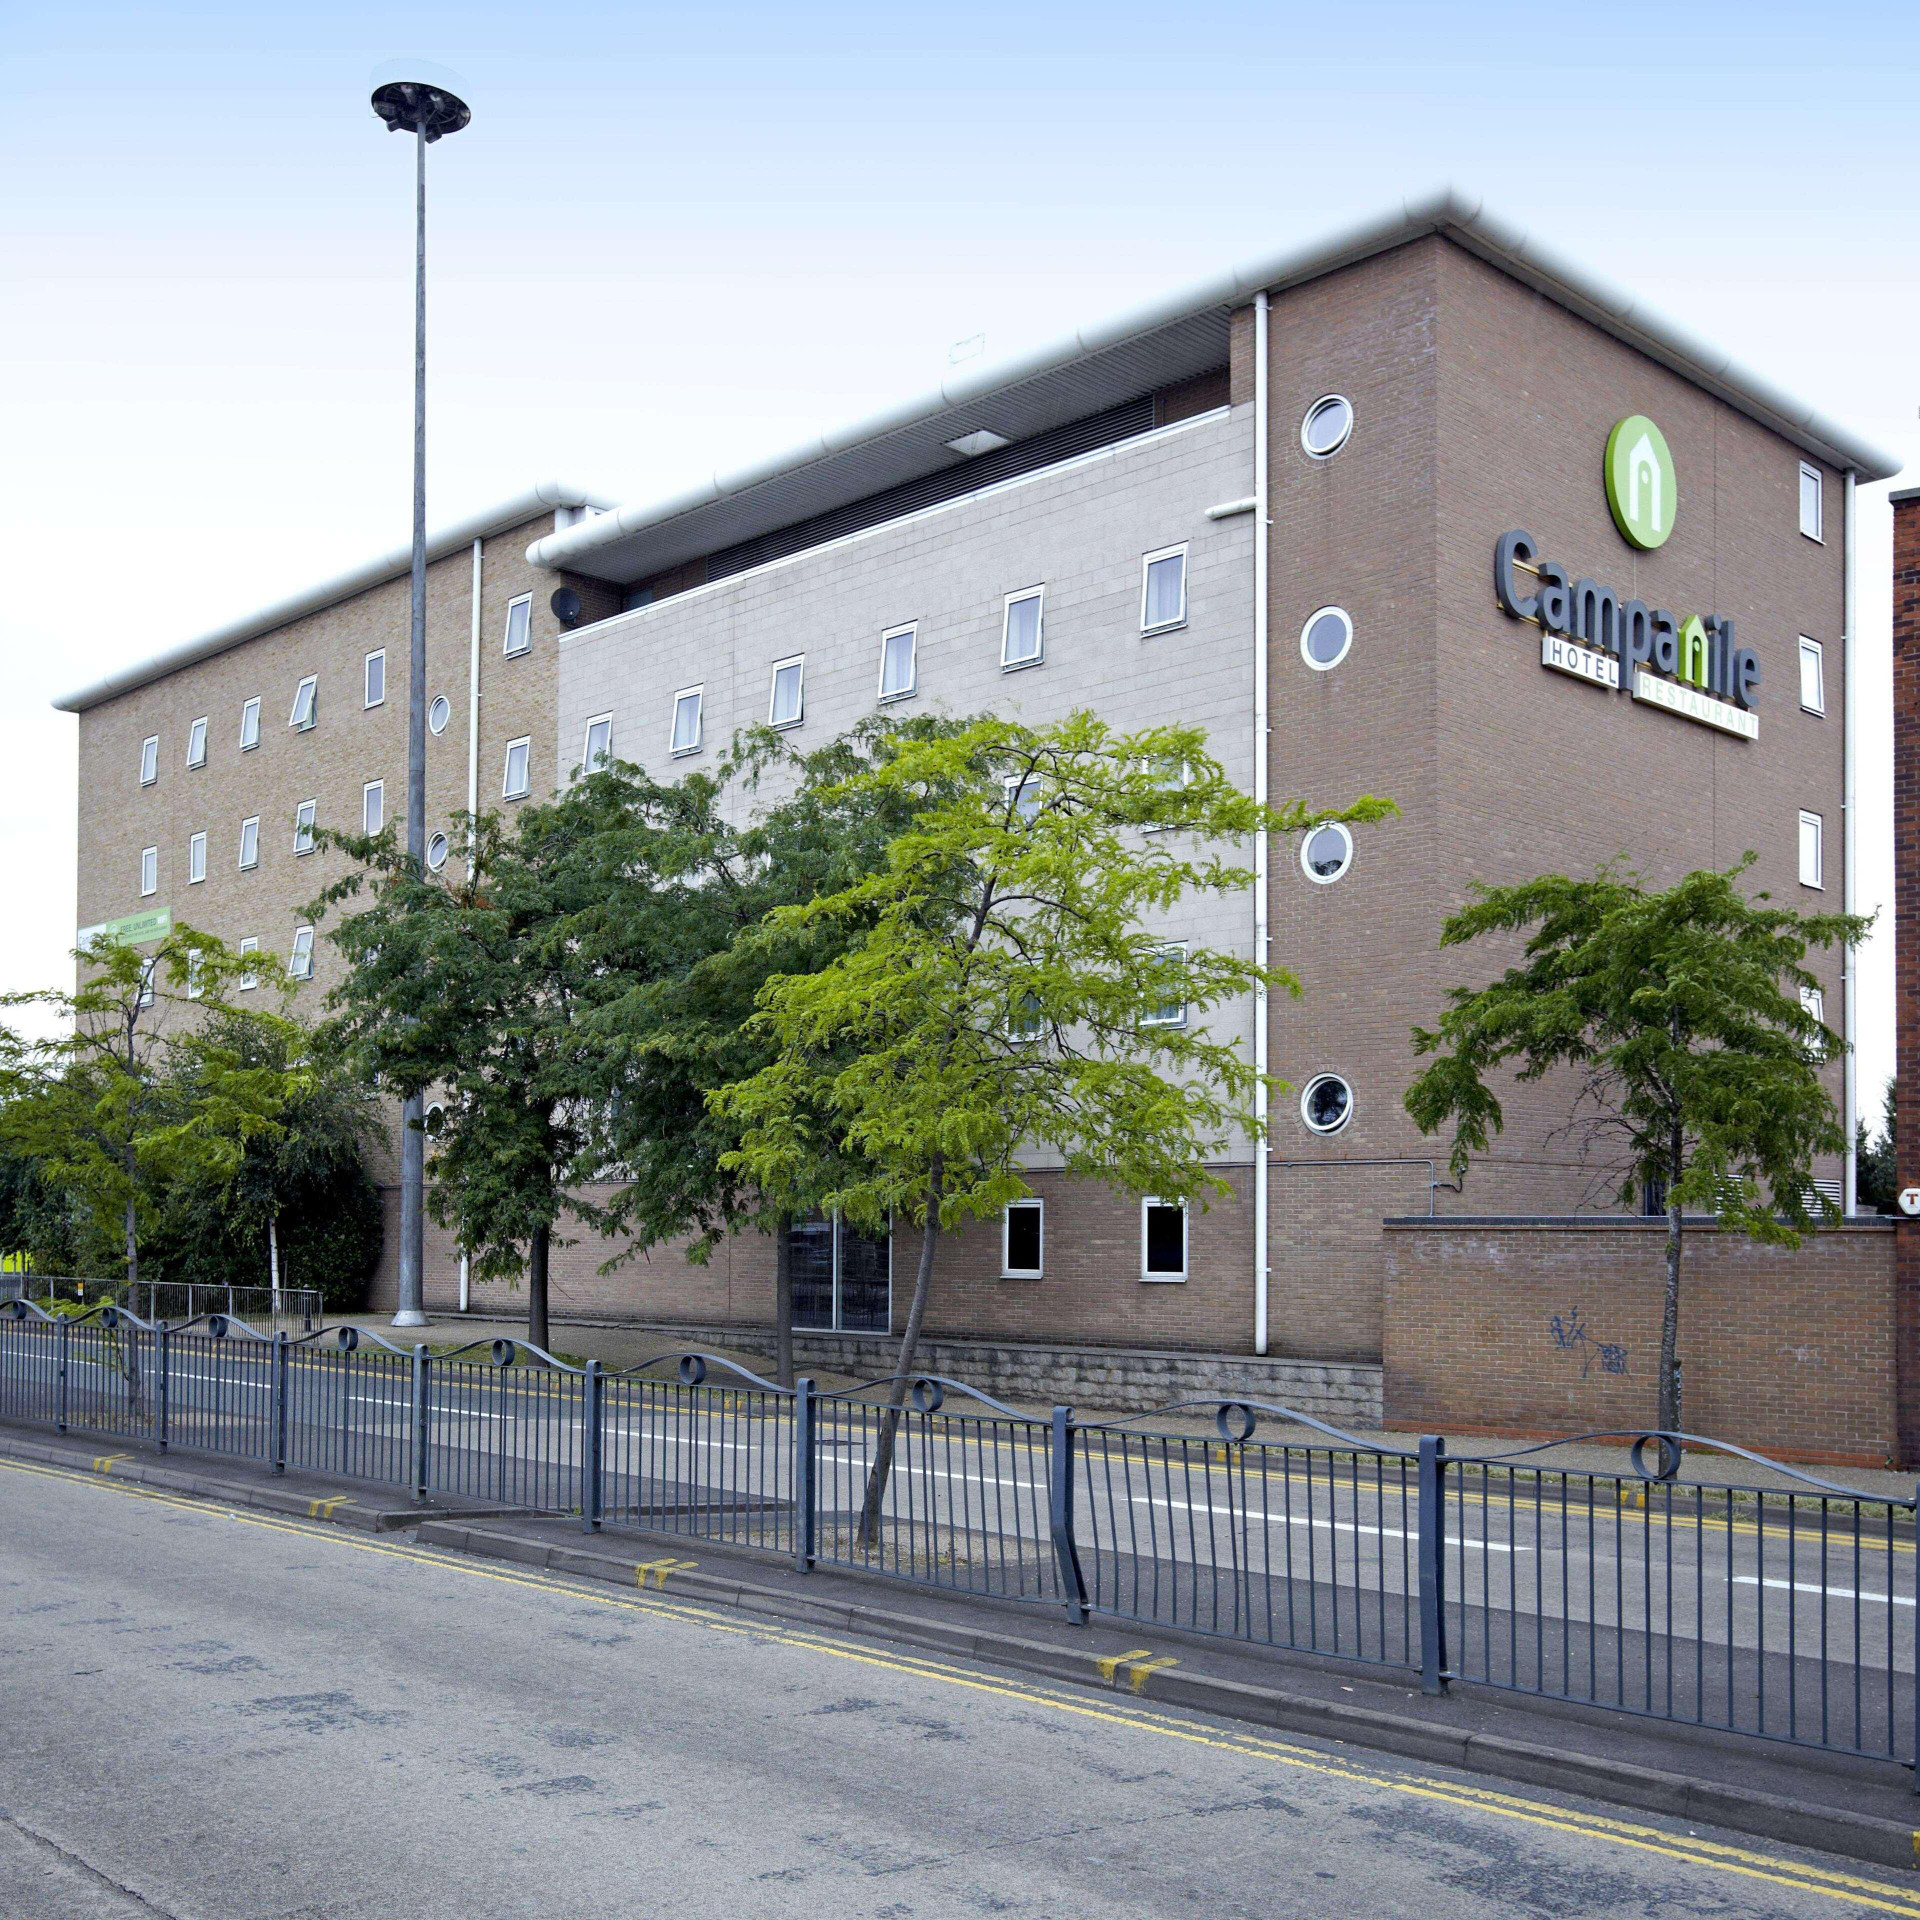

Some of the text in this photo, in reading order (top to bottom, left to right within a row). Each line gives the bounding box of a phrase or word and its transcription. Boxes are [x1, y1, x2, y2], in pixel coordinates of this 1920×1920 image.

[1496, 529, 1760, 708] Campanile
[1552, 642, 1617, 685] HOTEL
[1642, 675, 1758, 738] RESTAURANT
[120, 924, 132, 933] FREE
